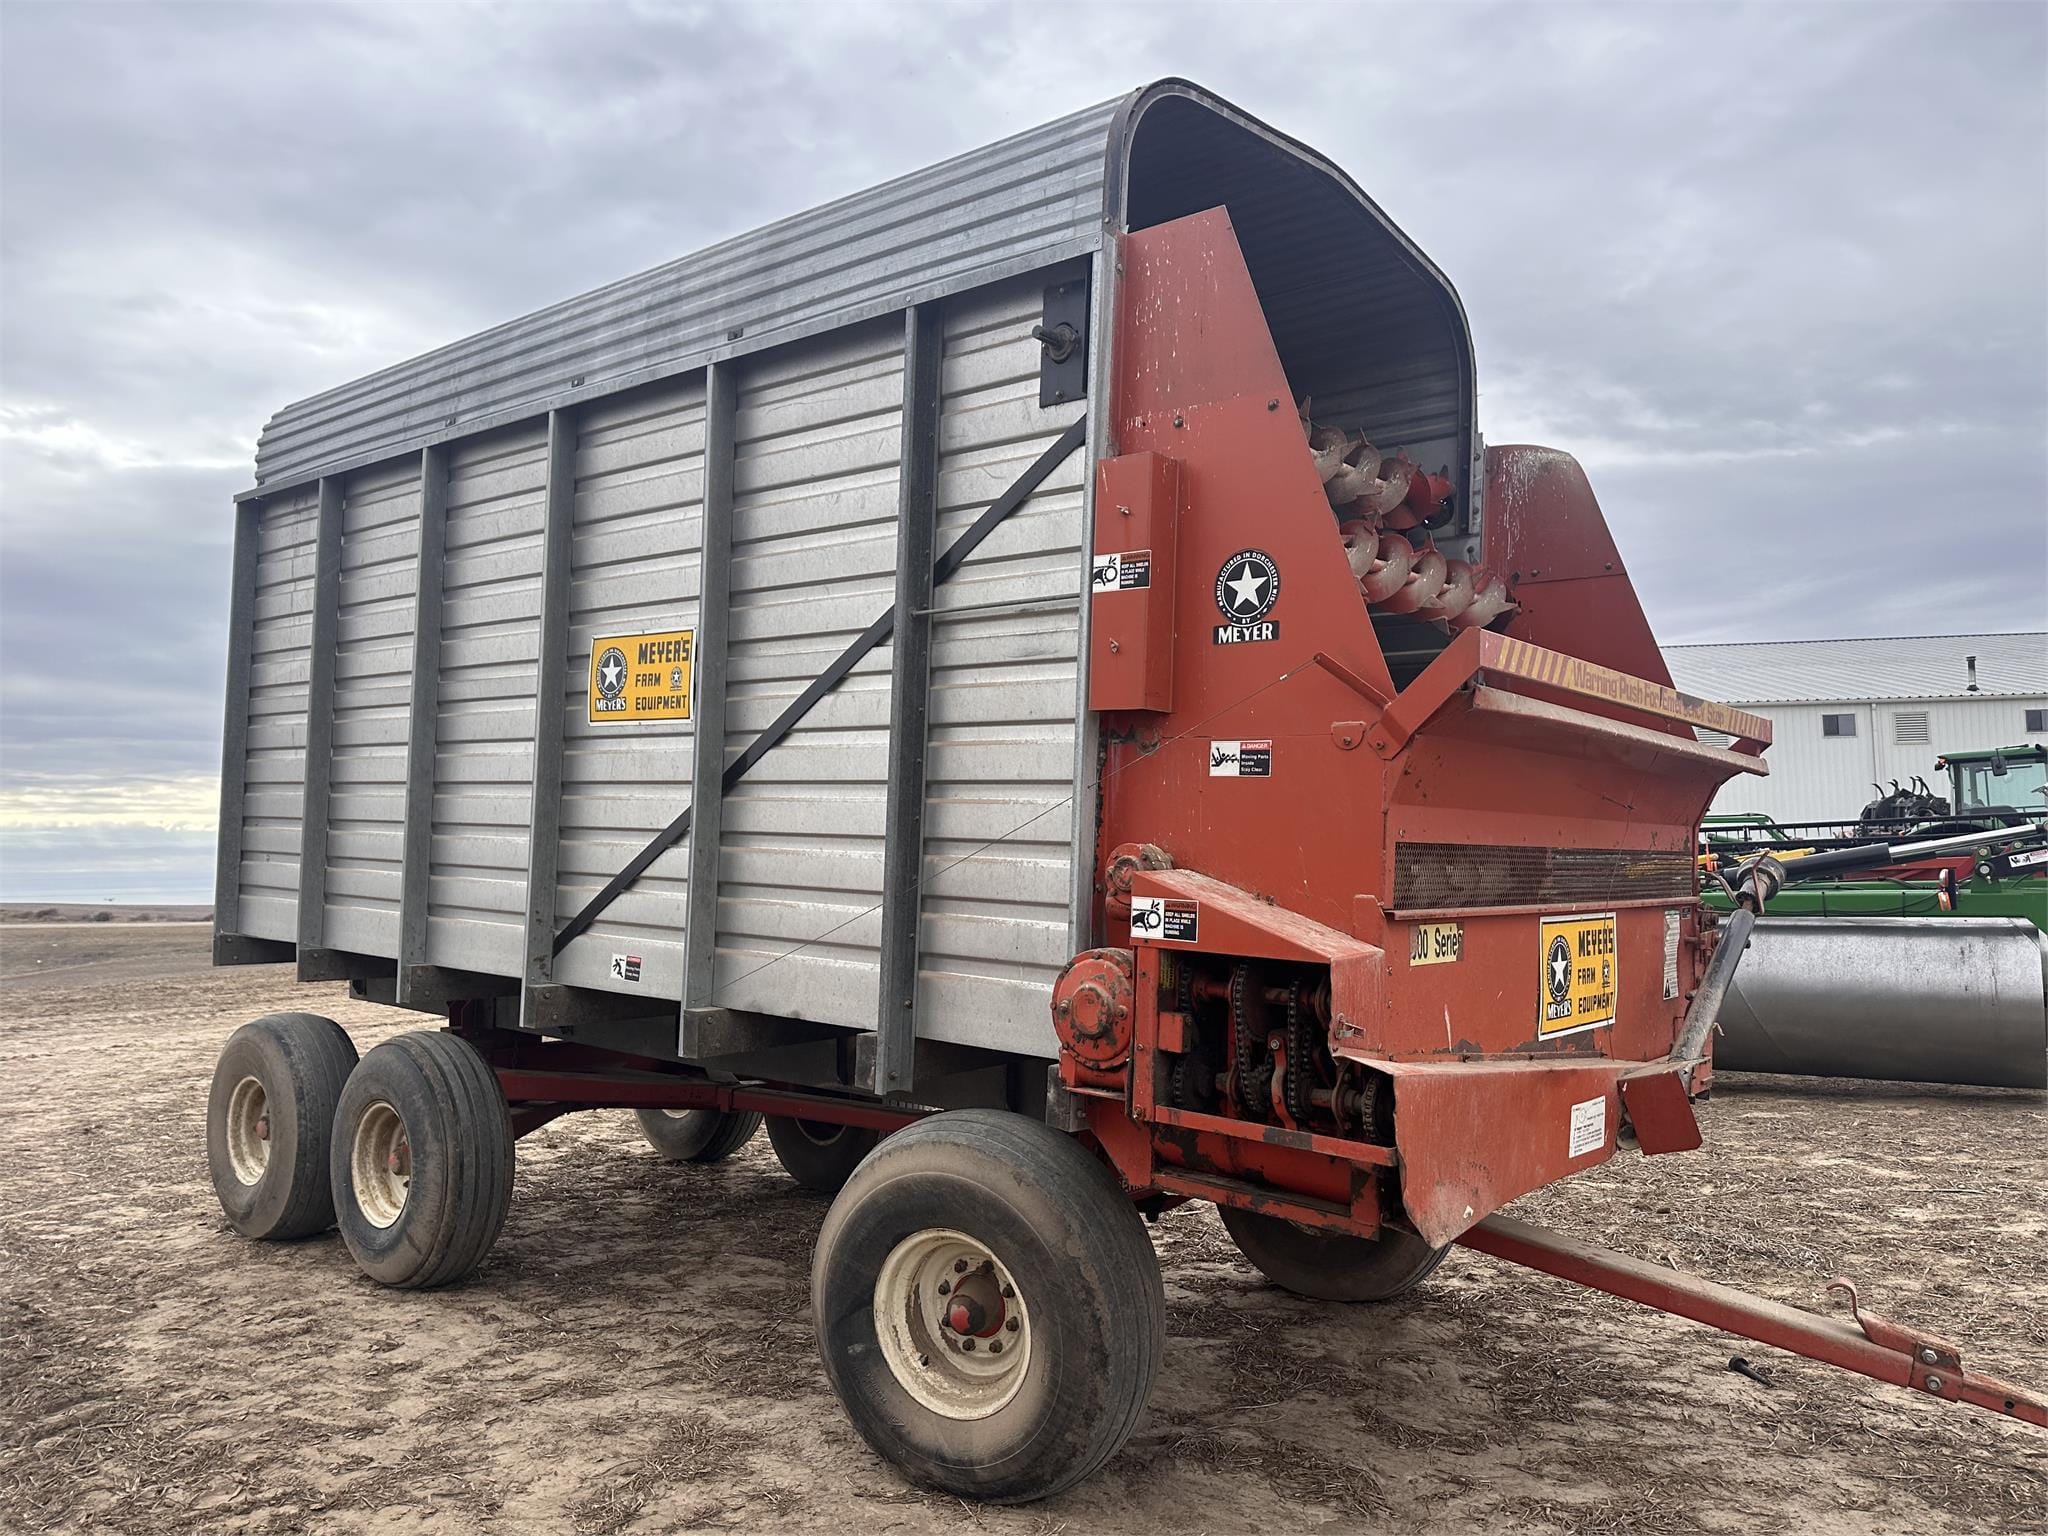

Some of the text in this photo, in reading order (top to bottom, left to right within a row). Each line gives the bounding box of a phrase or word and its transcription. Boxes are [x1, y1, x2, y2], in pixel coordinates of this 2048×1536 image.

[1252, 551, 1279, 587] DORCHESTER
[1217, 622, 1274, 645] MEYER
[638, 637, 690, 665] MEYER'S
[635, 673, 661, 687] FARM
[1573, 661, 1617, 699] Warning
[1619, 675, 1643, 704] Push
[635, 695, 687, 711] EQUIPMENT
[1413, 929, 1428, 960] 00
[1577, 967, 1596, 985] FARM
[1578, 991, 1613, 1014] EQUIPMENT
